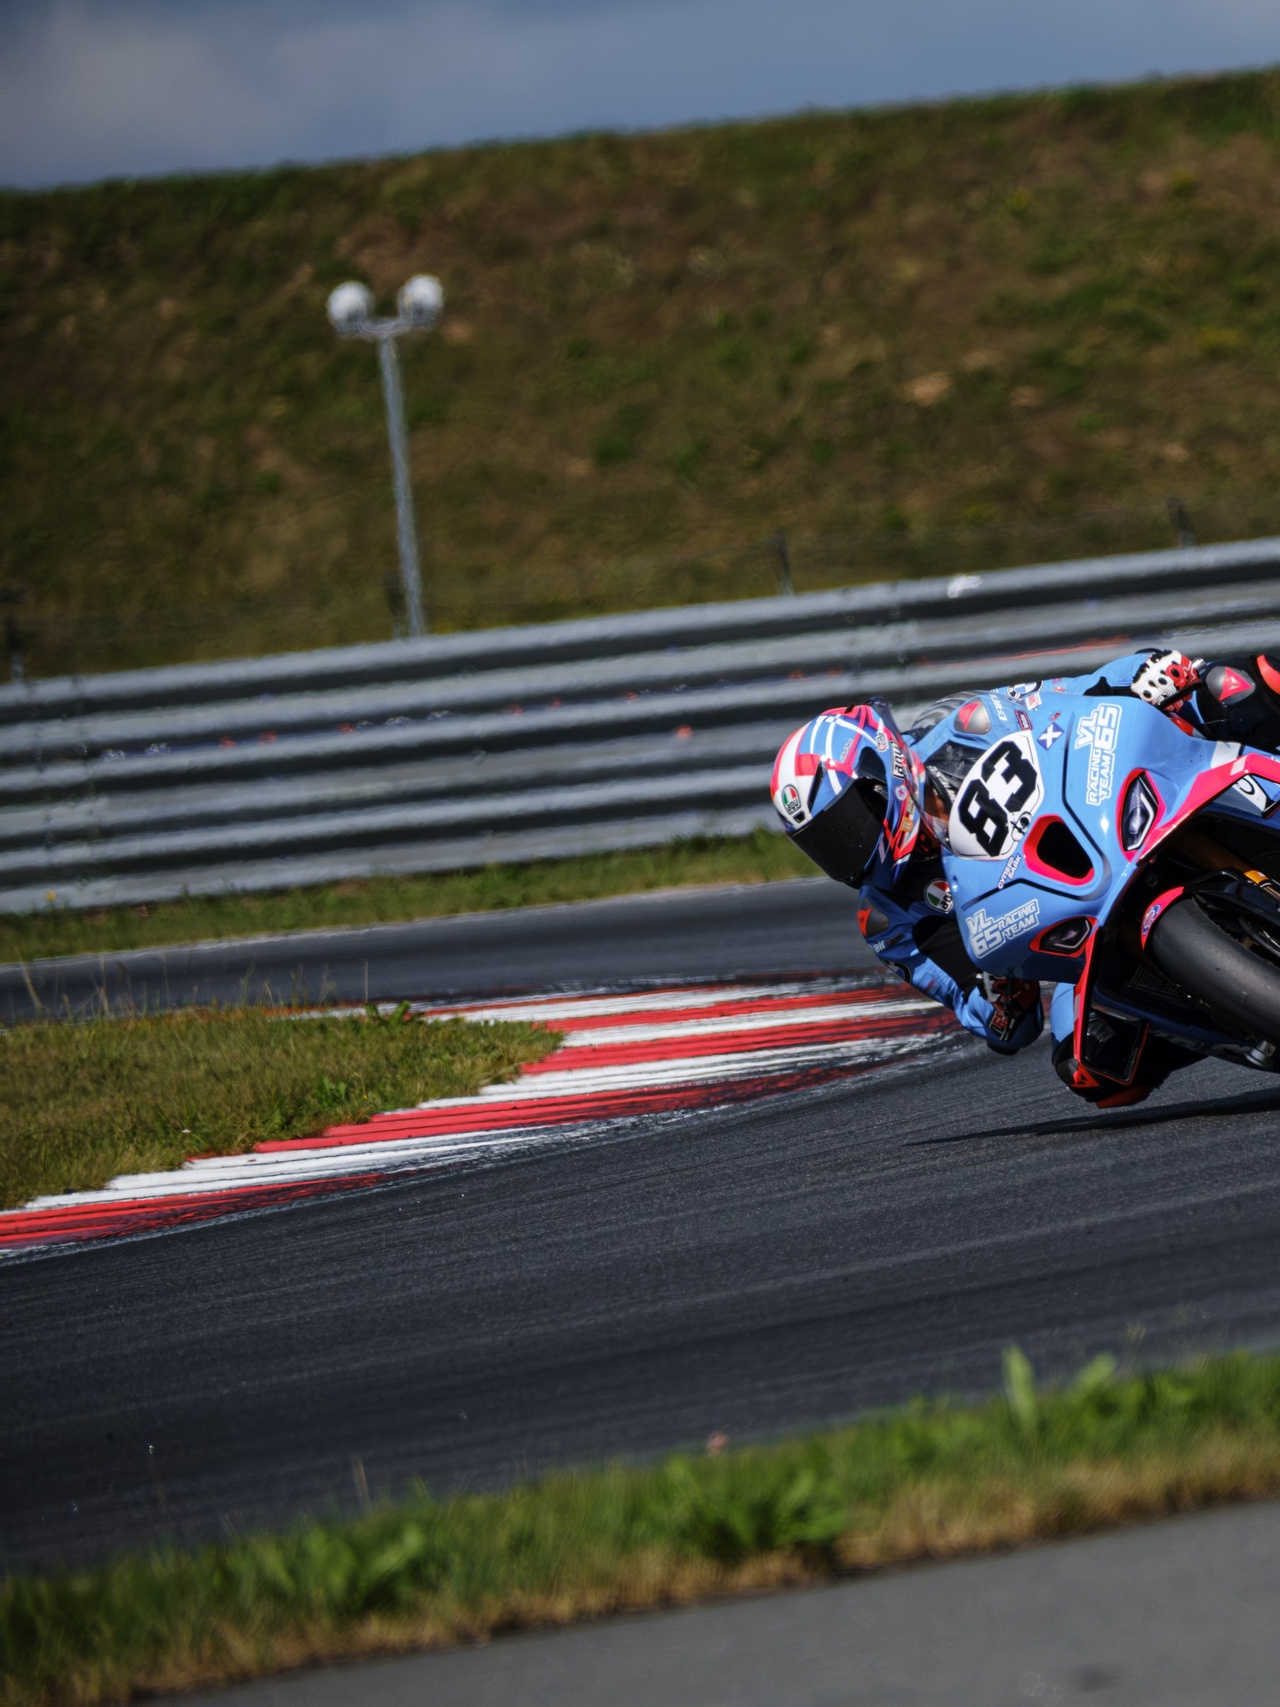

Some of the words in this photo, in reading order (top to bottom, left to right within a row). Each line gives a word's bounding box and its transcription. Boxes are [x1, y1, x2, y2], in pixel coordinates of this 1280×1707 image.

[1075, 711, 1098, 749] VL
[1093, 705, 1119, 751] 65
[1088, 747, 1102, 804] RACING
[1099, 754, 1112, 798] TEAM
[958, 740, 1038, 858] 83
[966, 909, 993, 935] VL
[999, 902, 1037, 931] RACING
[1004, 914, 1036, 938] TEAM
[970, 924, 1003, 957] 65
